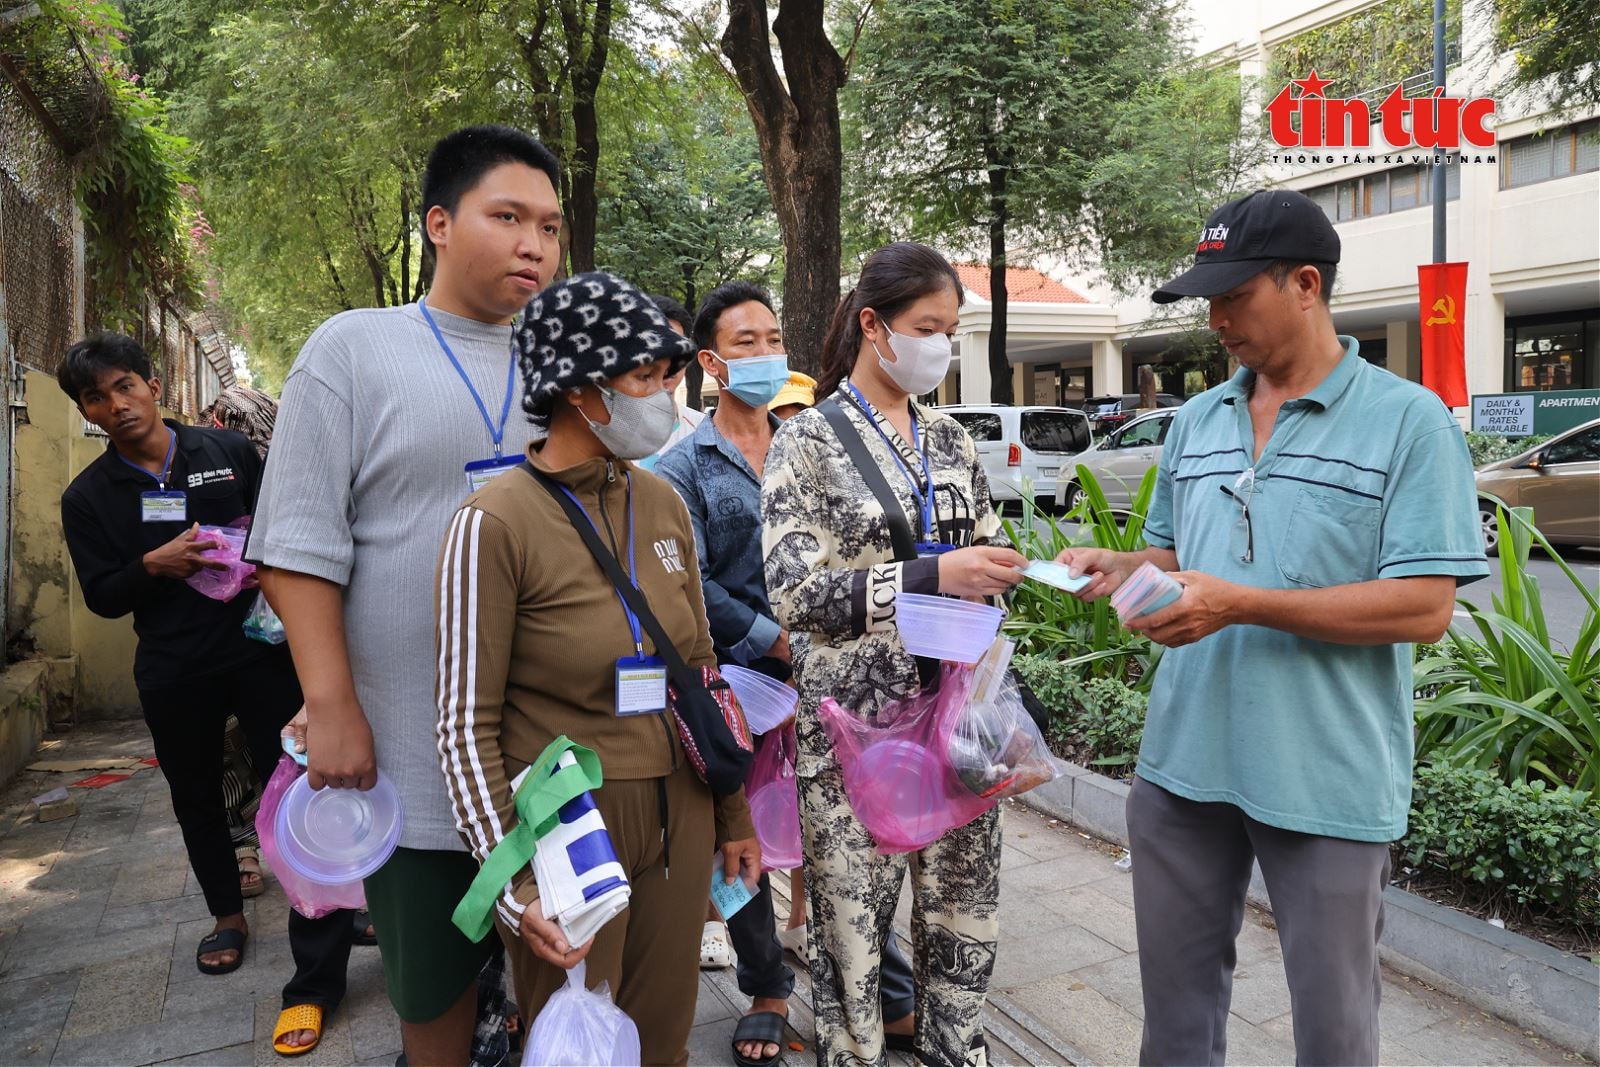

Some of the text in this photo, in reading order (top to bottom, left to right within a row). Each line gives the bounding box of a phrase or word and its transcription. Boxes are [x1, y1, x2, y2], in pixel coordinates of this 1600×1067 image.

[1487, 400, 1512, 408] DAILY
[1480, 408, 1525, 416] MONTHLY
[1489, 416, 1518, 424] RATES
[1480, 425, 1528, 433] AVAILABLE
[187, 472, 203, 488] 93
